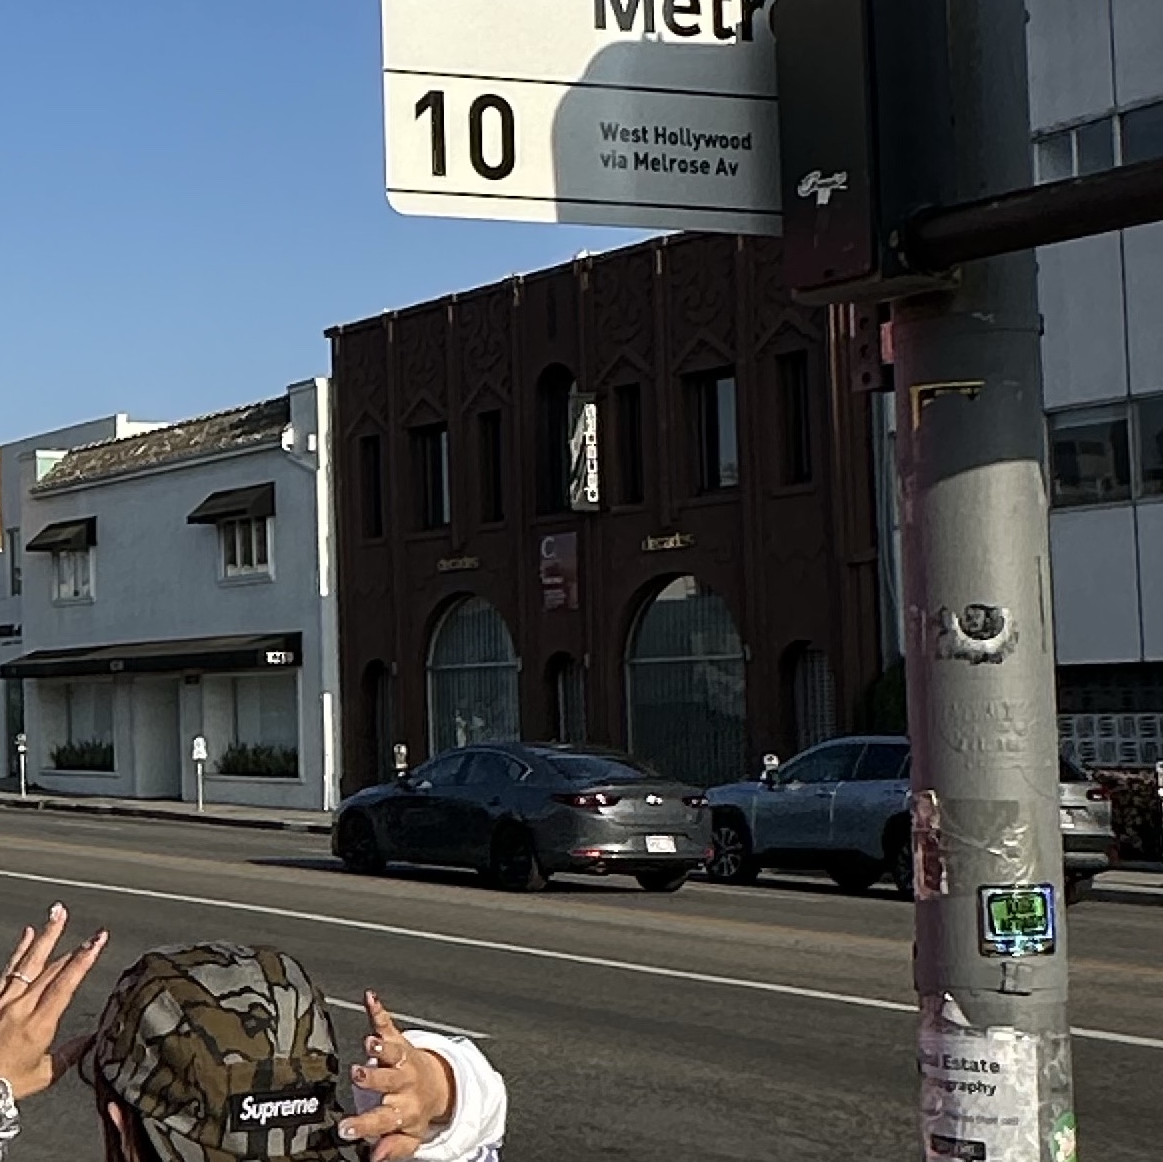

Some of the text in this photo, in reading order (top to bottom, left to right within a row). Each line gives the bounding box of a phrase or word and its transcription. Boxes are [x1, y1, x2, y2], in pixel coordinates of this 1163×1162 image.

[594, 0, 776, 42] Metr
[414, 90, 515, 181] 10
[599, 121, 753, 151] West Hollywood
[599, 151, 739, 178] via Melrose Av
[942, 1053, 1001, 1074] Estate
[239, 1095, 319, 1125] Supreme
